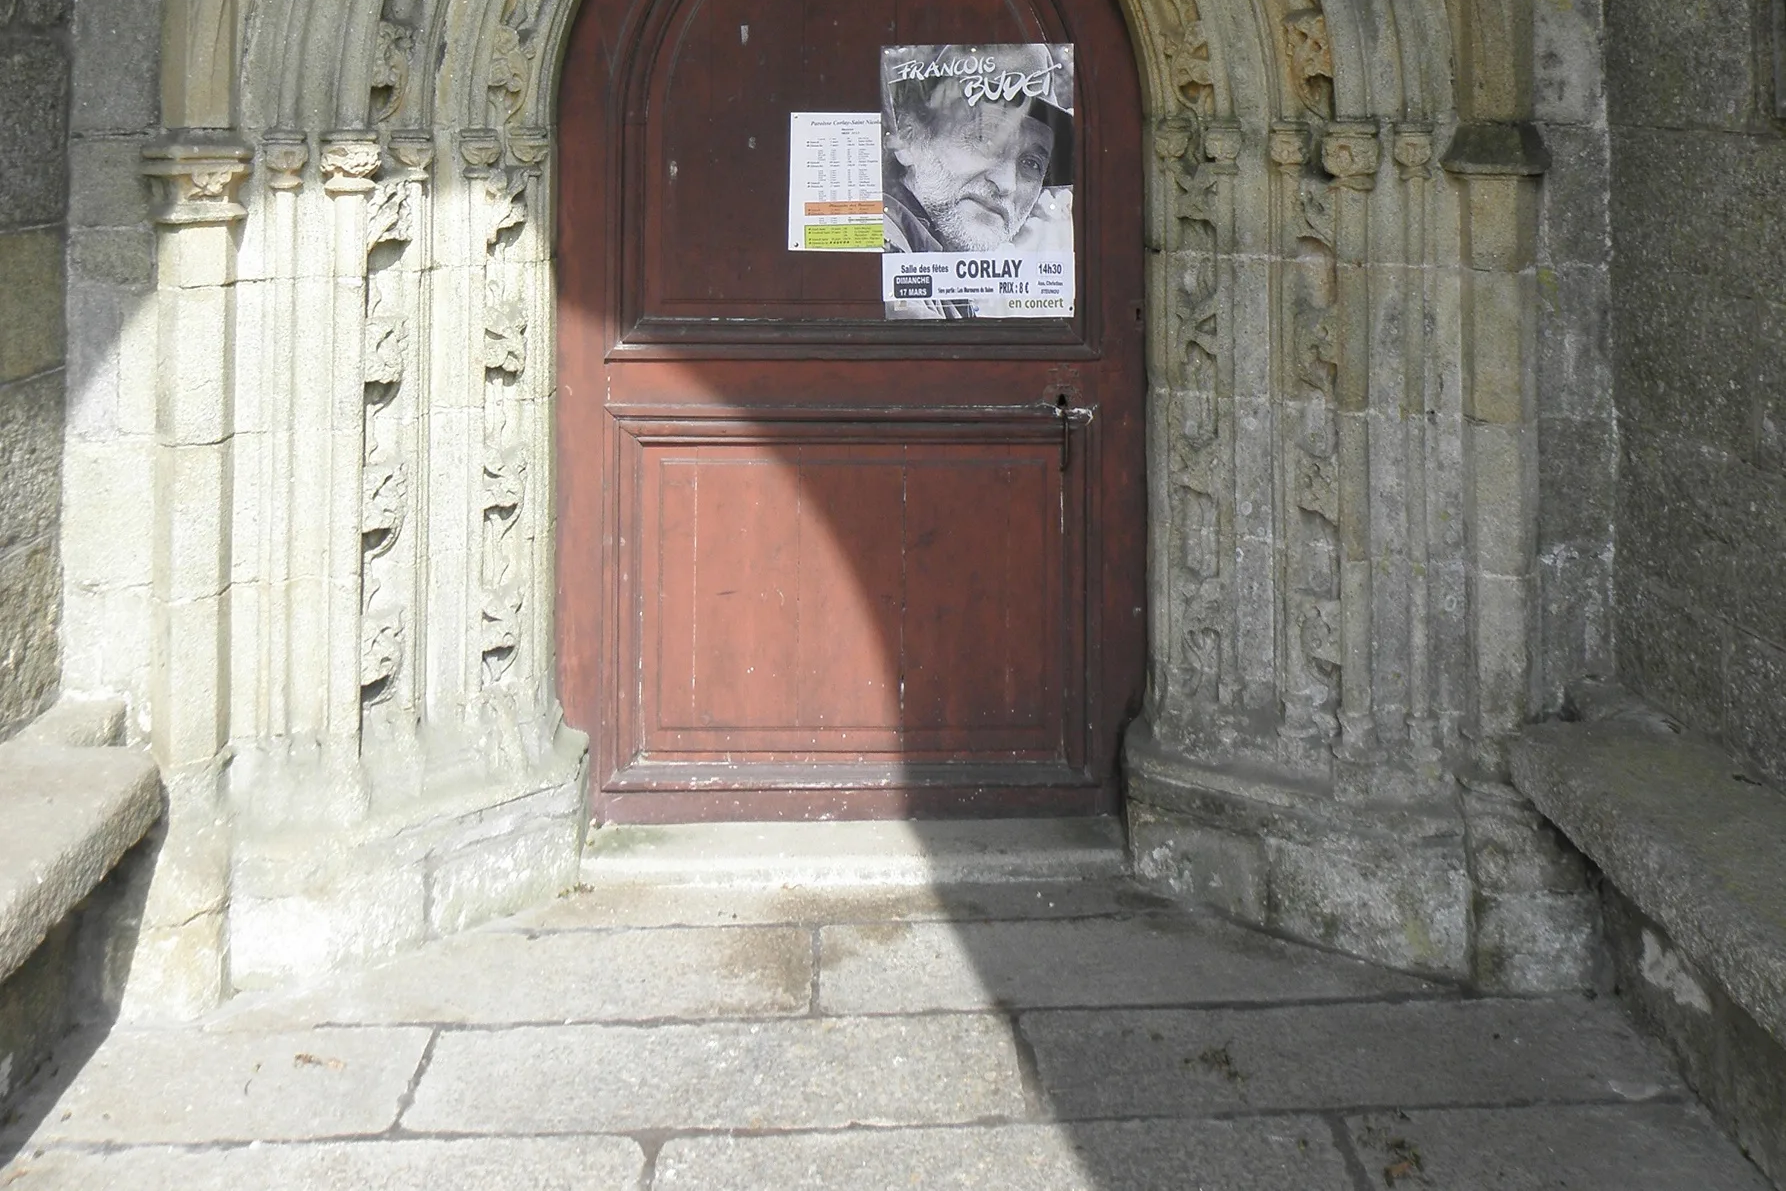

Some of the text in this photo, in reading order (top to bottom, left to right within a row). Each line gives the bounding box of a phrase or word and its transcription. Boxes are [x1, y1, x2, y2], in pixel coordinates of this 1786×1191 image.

[959, 63, 1062, 107] BUDET
[901, 259, 1022, 278] Salle des fêtes CORLAY
[1038, 263, 1062, 274] 14h30
[896, 276, 930, 284] DIMANCHE
[899, 288, 927, 296] 17 MARS
[999, 282, 1014, 294] PRIX
[1019, 282, 1023, 294] 8
[1024, 281, 1029, 294] €
[1009, 298, 1064, 308] en concert
